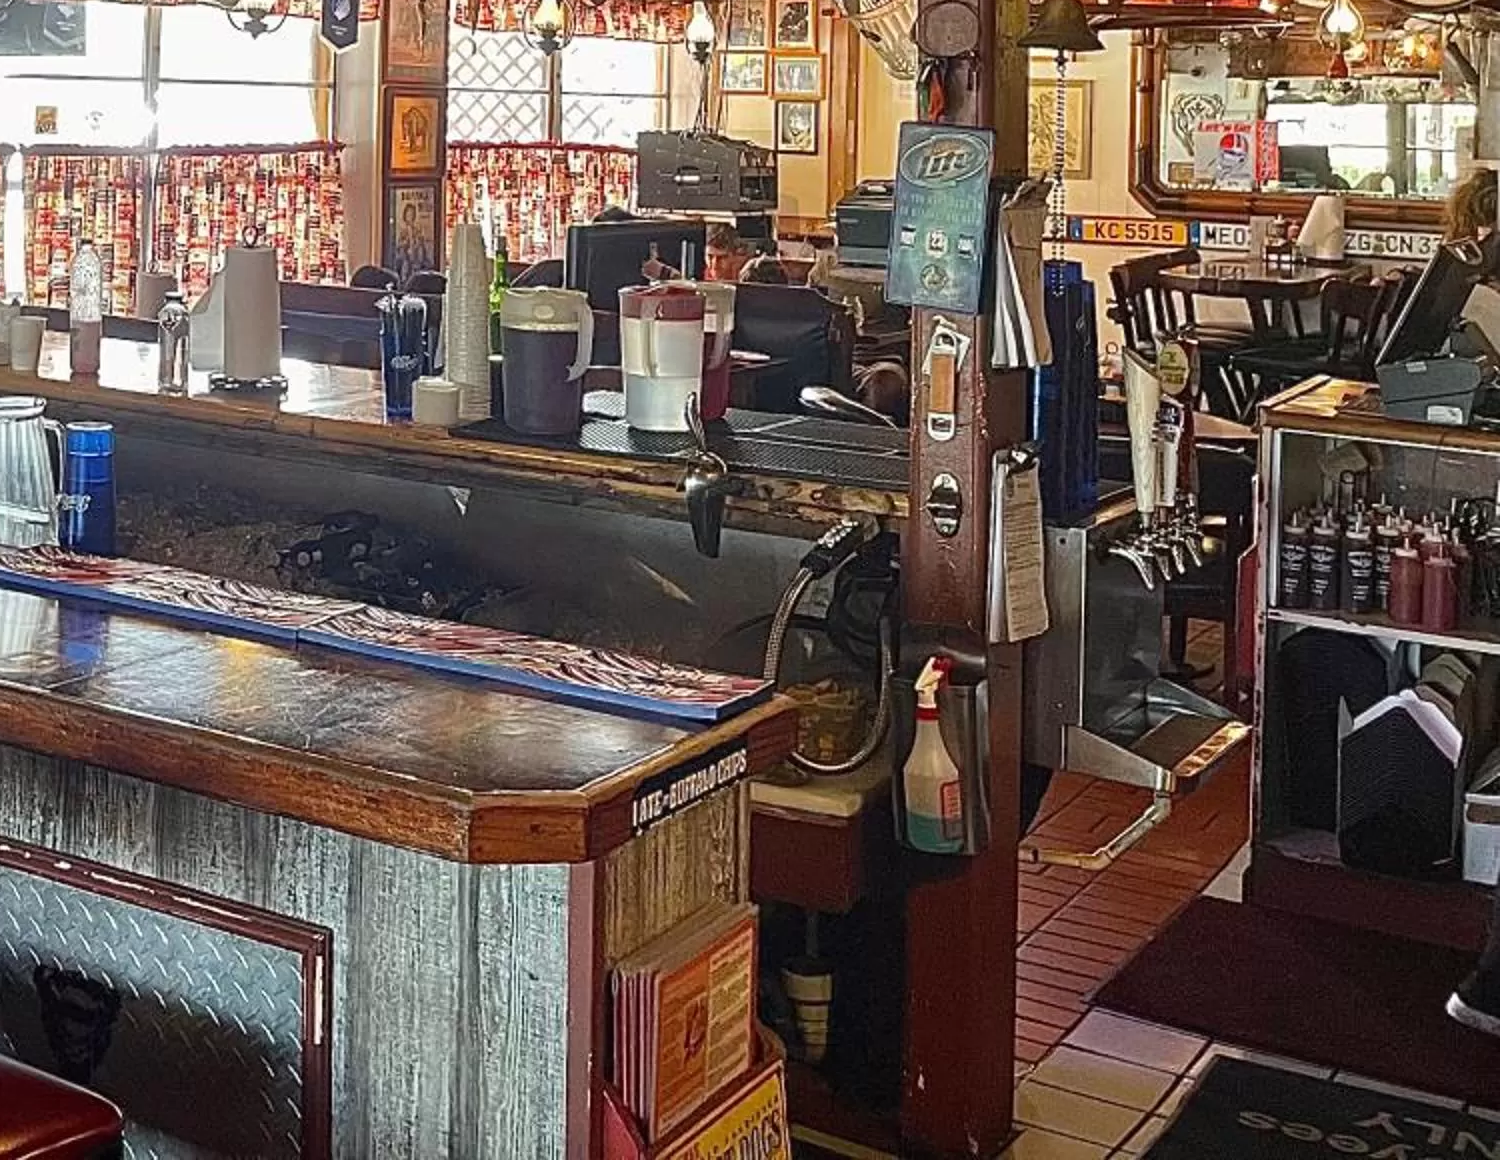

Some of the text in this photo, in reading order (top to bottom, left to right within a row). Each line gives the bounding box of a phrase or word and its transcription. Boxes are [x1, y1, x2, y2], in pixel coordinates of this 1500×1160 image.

[1095, 223, 1174, 241] KC 5515
[639, 789, 663, 823] ATE
